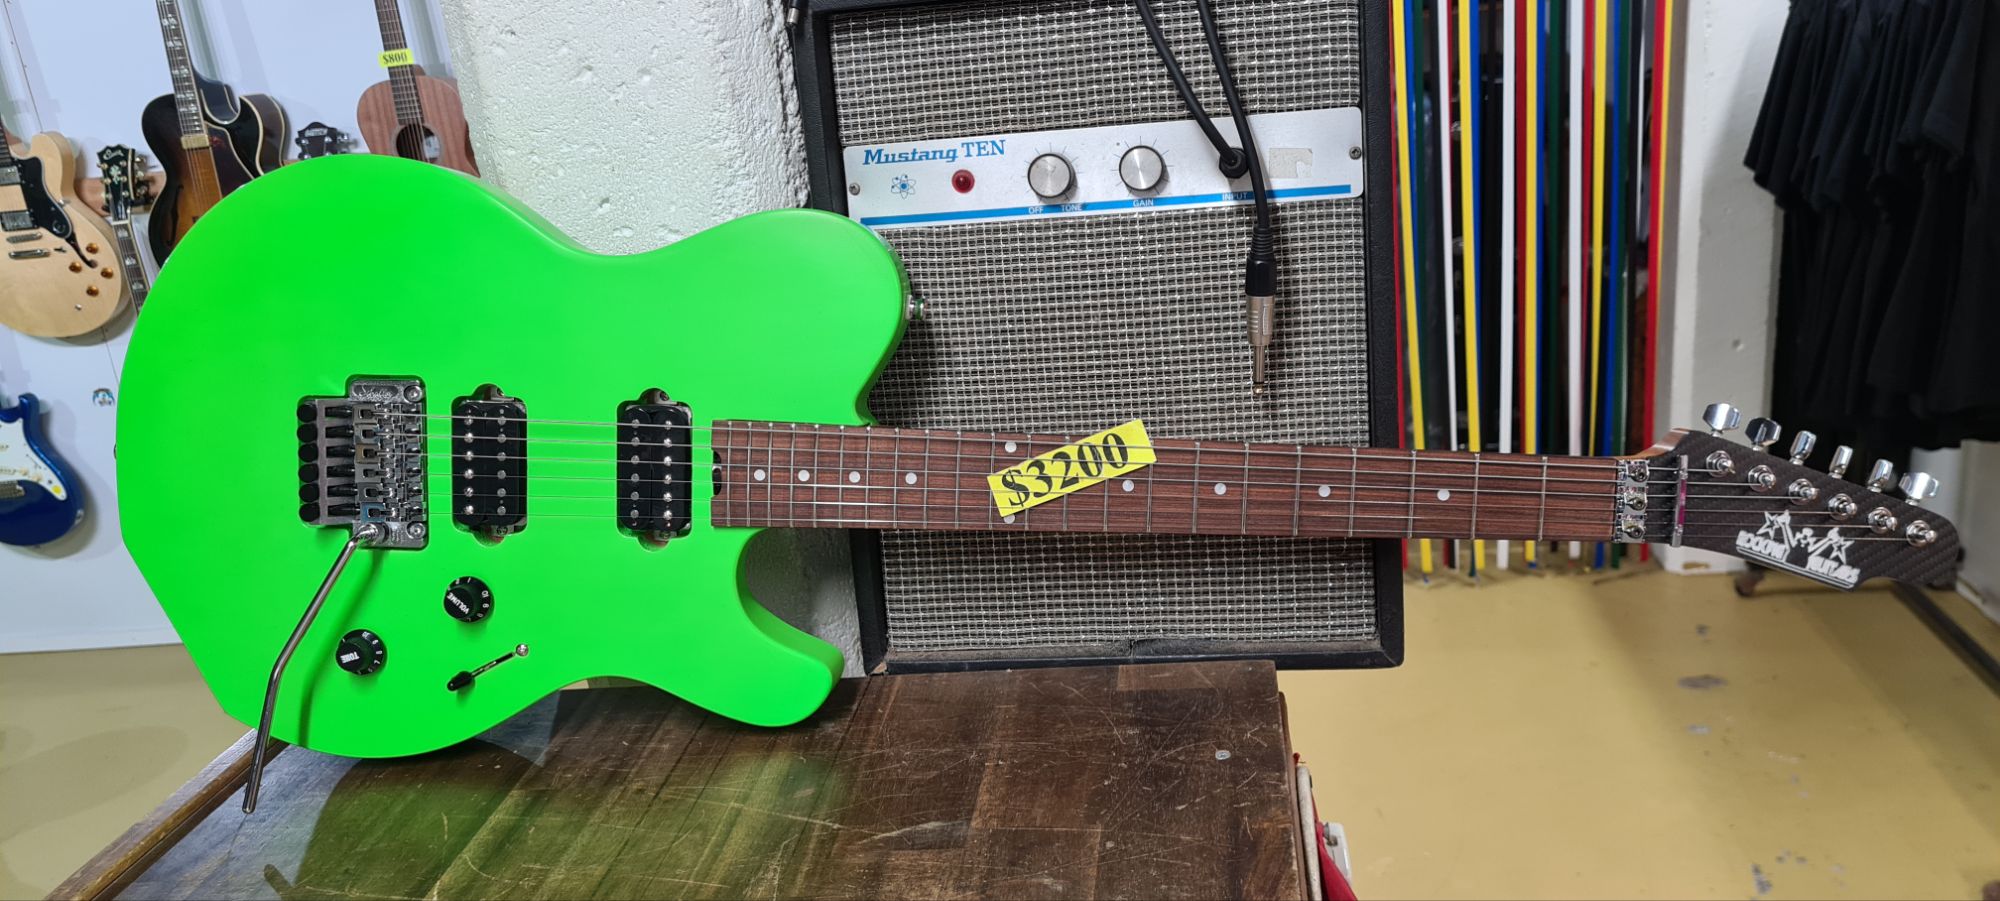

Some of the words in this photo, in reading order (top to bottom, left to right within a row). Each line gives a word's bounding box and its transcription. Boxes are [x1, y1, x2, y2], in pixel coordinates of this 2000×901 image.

[382, 51, 408, 65] $800
[862, 148, 958, 165] Mustang
[961, 140, 1006, 157] TEN
[1132, 198, 1154, 207] GAIN
[1222, 192, 1248, 201] INPUT
[1028, 206, 1044, 214] OFF
[1061, 203, 1083, 213] TONE
[1001, 432, 1129, 508] $3200
[446, 592, 470, 615] VOLUME
[340, 651, 360, 664] TONE
